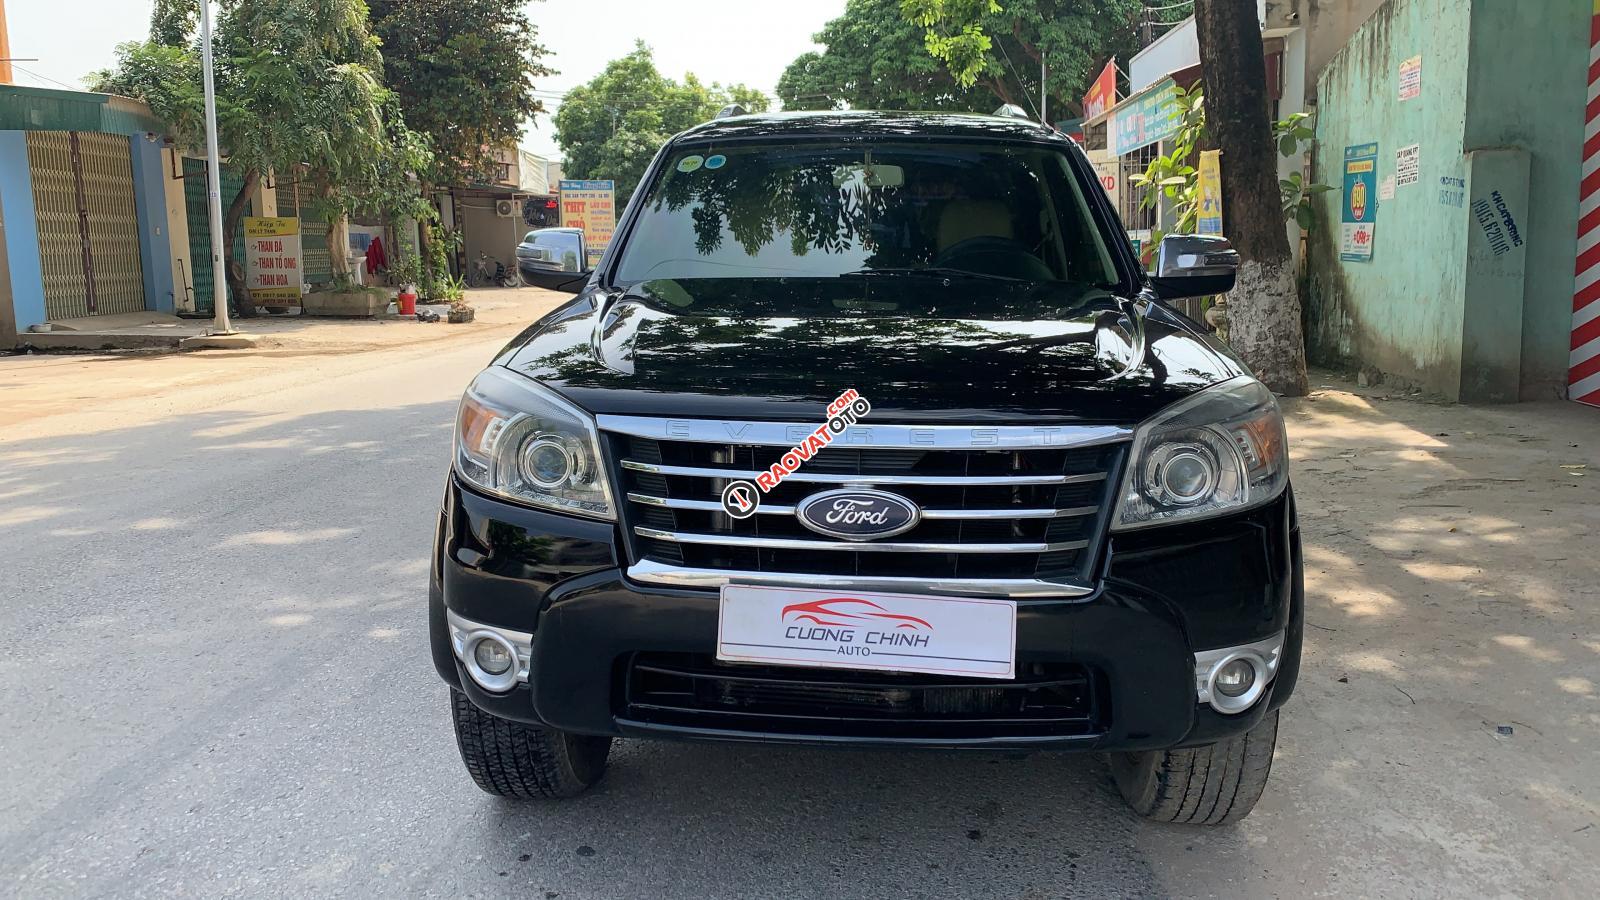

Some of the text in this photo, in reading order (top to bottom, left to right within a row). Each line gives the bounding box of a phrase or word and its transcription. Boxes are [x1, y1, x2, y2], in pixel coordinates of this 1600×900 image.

[258, 239, 283, 252] THAN ĐÁ
[259, 258, 274, 269] THAN
[284, 258, 297, 269] ONG
[260, 274, 275, 286] THAN
[666, 419, 1062, 446] EVEREST
[825, 498, 888, 525] Ford
[785, 625, 930, 648] CUONG CHINH
[836, 645, 871, 657] AUTO
